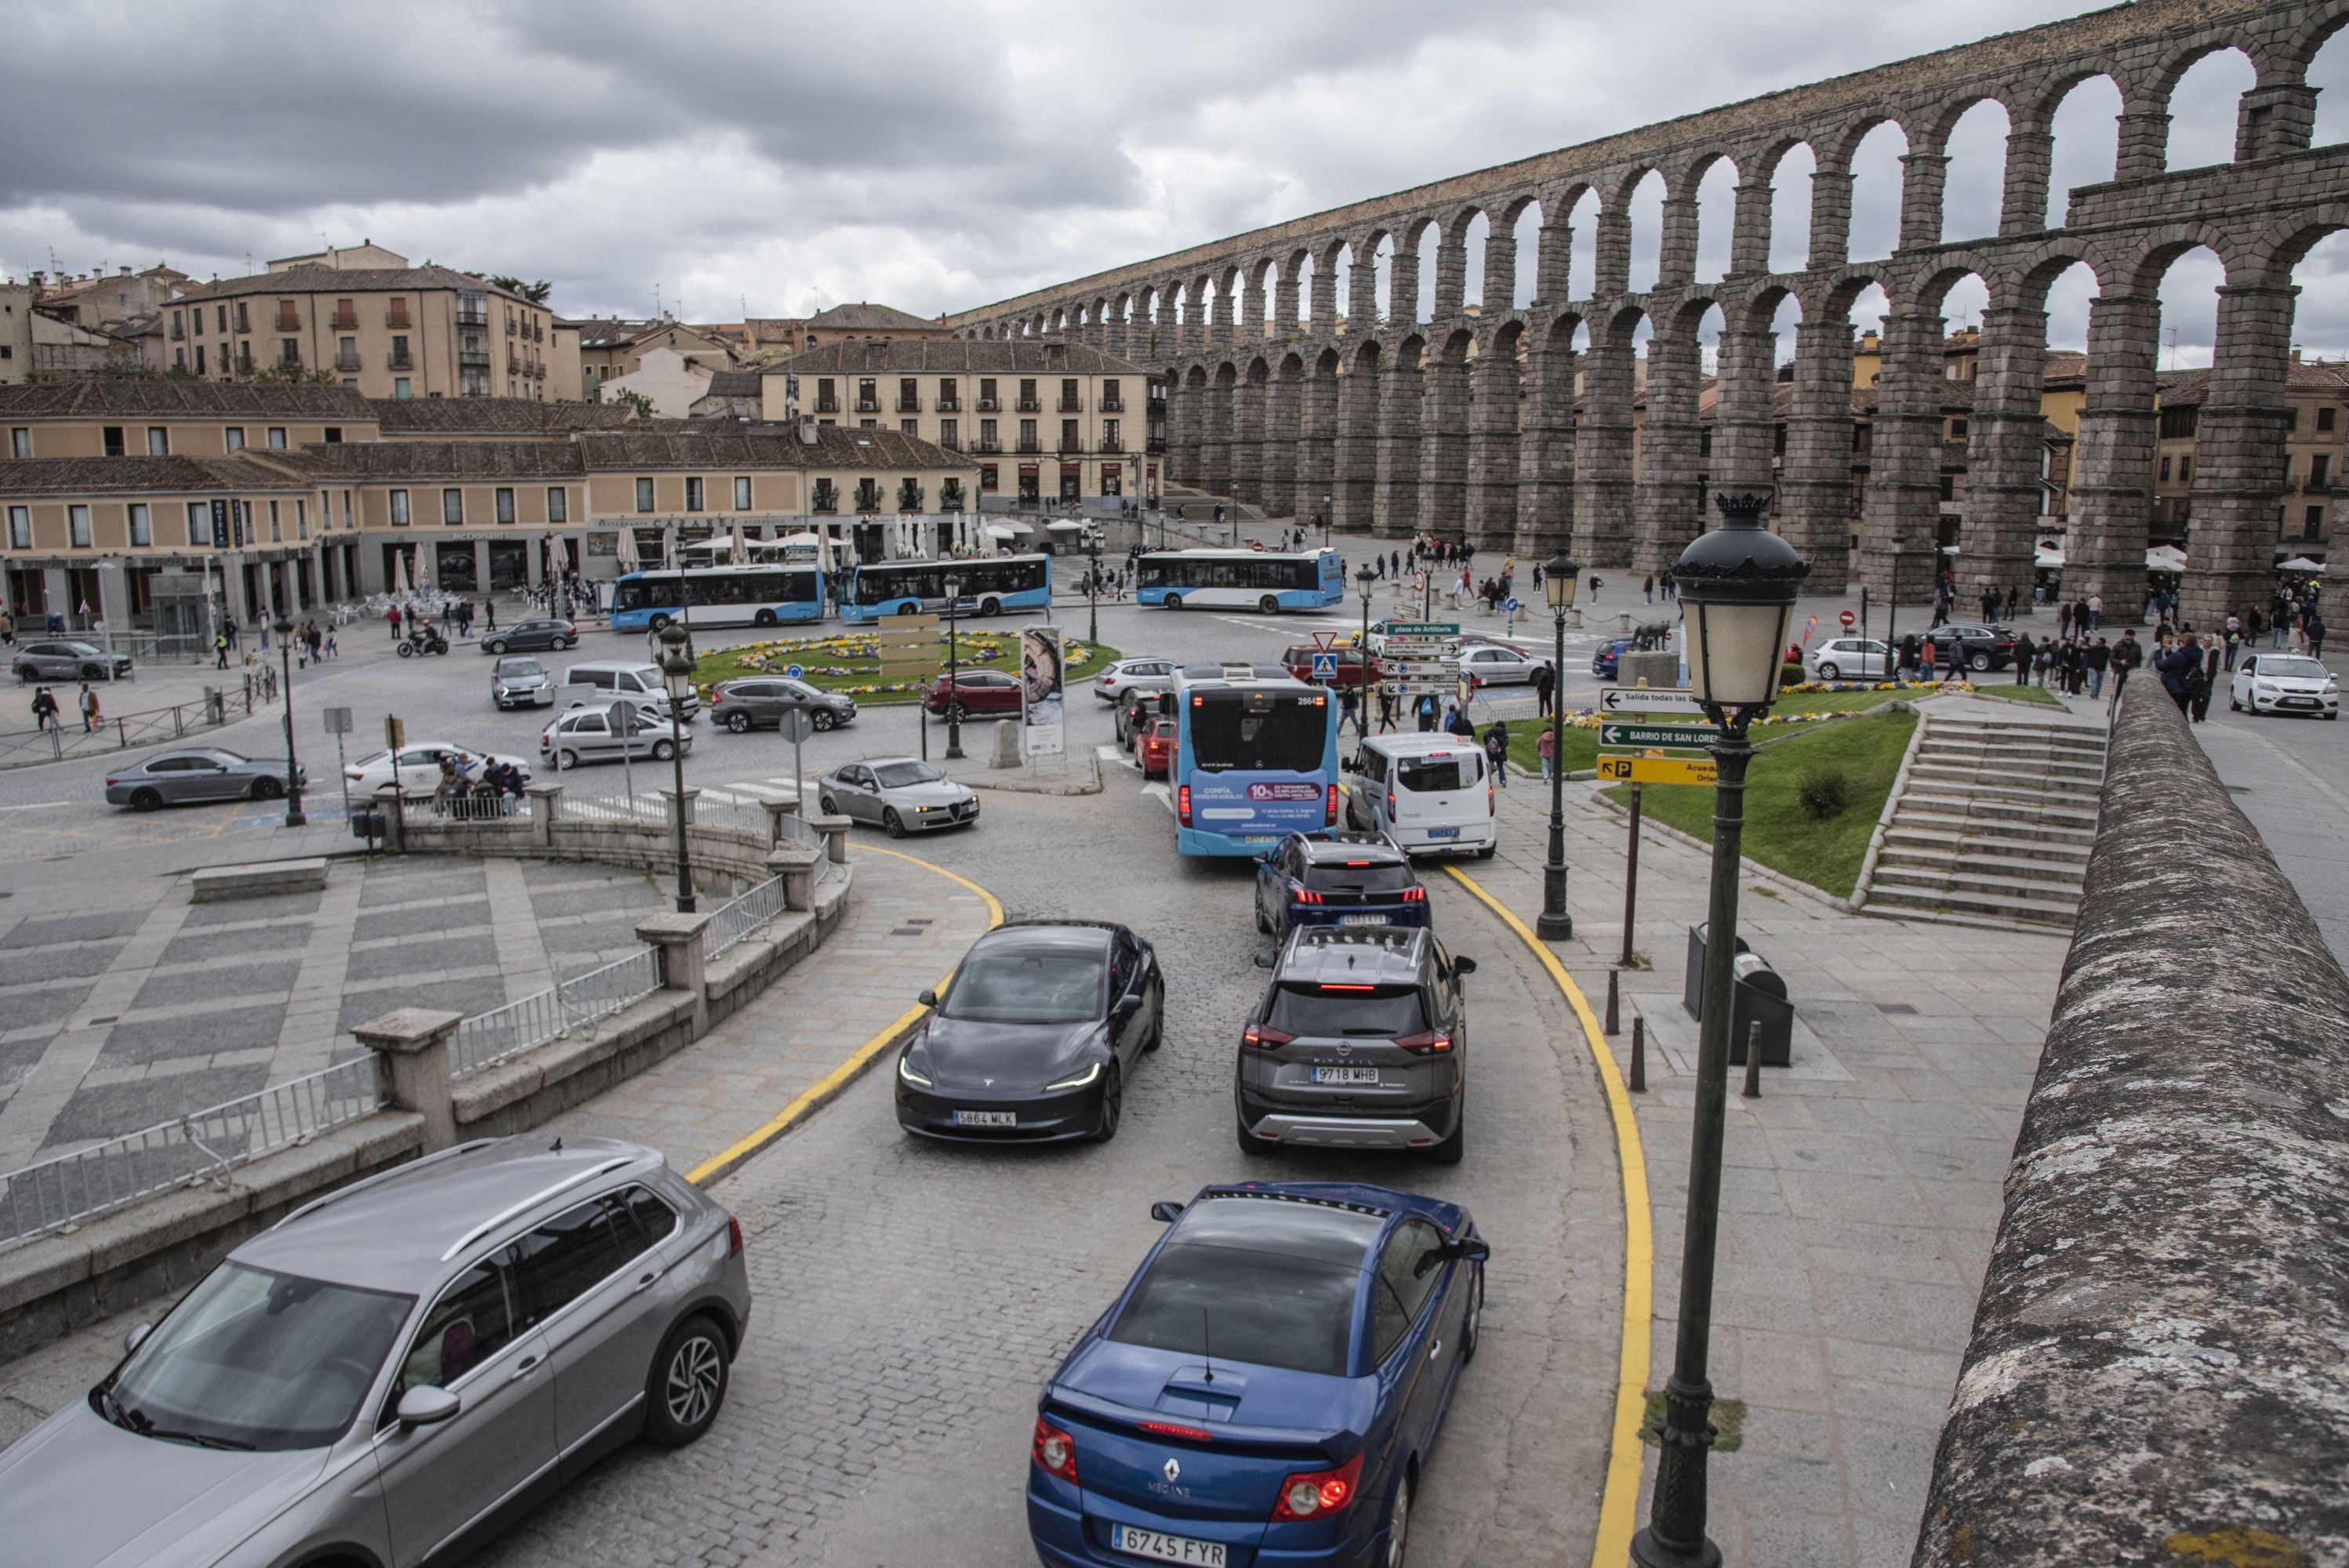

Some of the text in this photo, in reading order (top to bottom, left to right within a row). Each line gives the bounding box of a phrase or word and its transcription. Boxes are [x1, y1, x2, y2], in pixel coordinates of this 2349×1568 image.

[215, 502, 224, 535] HOTEL
[1675, 694, 1686, 702] las
[1629, 731, 1659, 741] BARRIO
[1661, 732, 1672, 742] DE
[1674, 733, 1692, 742] SAN
[1251, 785, 1273, 797] 10%
[1319, 1068, 1377, 1080] 9718 MHB
[960, 1113, 1011, 1123] 5864 MLK
[1127, 1530, 1223, 1565] 6745 FYR
